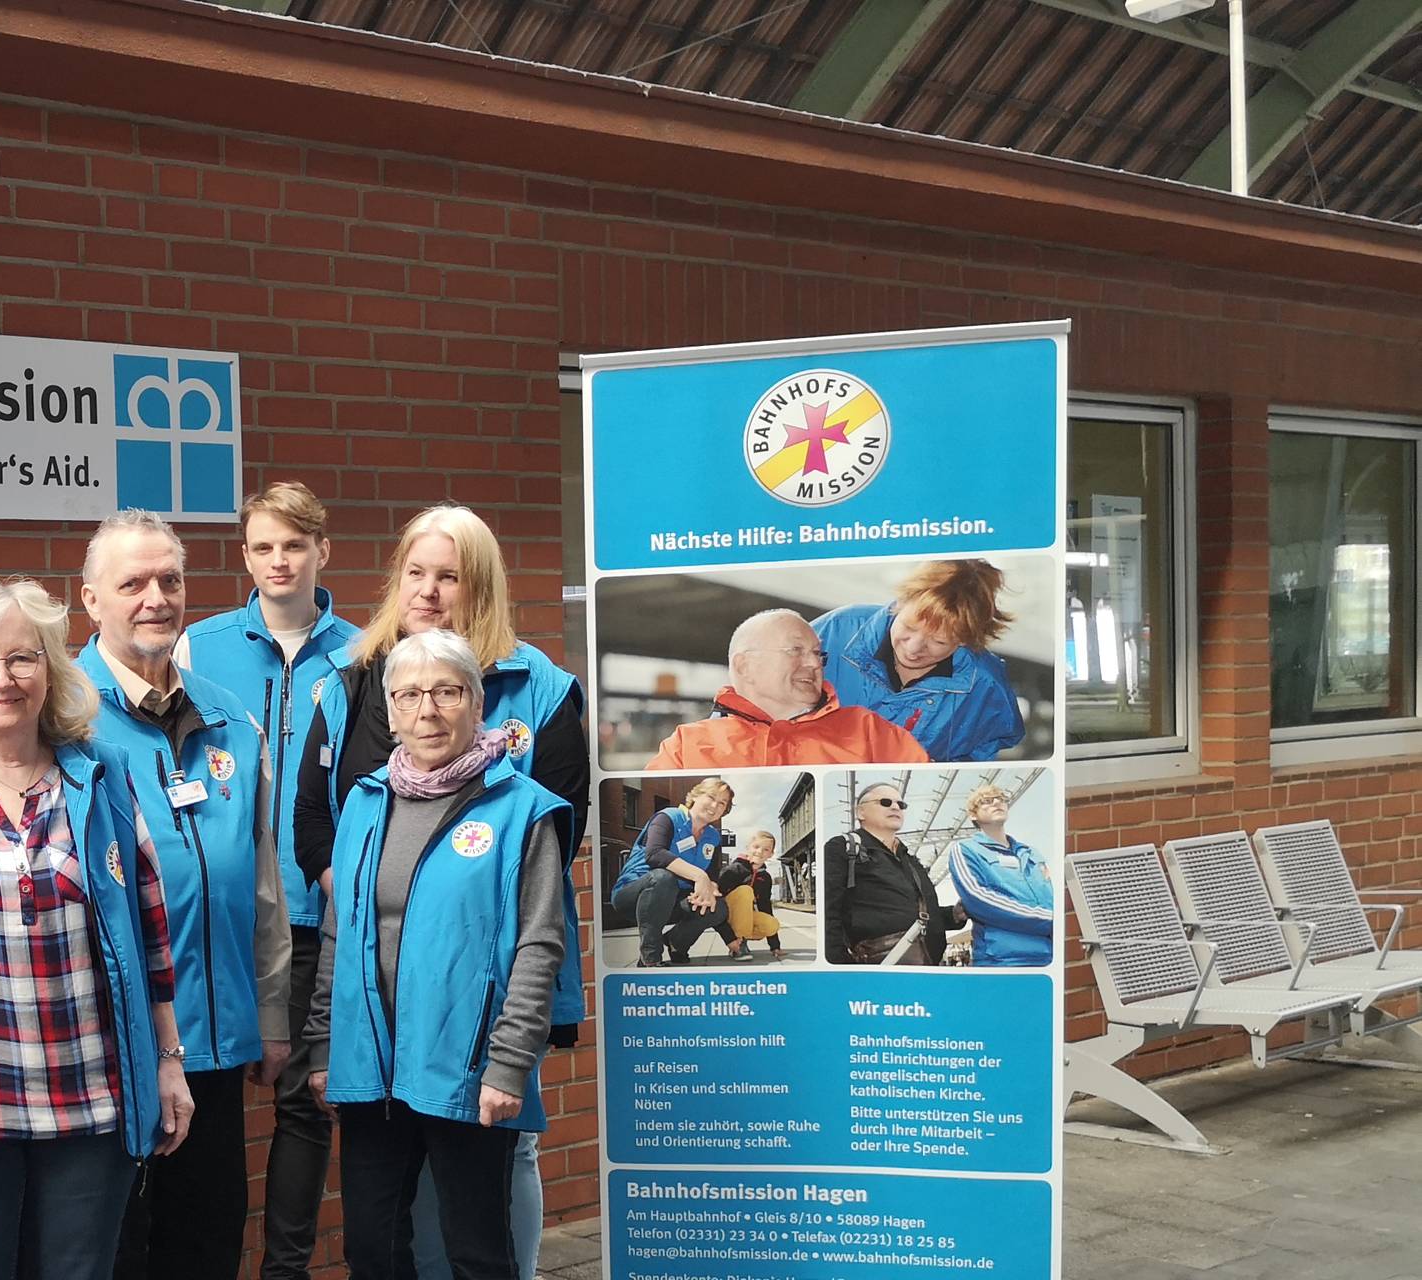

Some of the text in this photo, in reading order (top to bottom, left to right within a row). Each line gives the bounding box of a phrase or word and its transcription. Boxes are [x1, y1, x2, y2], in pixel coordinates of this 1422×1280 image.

[754, 378, 850, 452] BAHNHOFS
[43, 455, 100, 488] Aid.
[796, 436, 880, 499] MISSION
[650, 518, 994, 552] Nächste Hilfe: Bahnhofsmission.
[622, 980, 787, 996] Menschen brauchen
[622, 1002, 754, 1016] manchmal Hilfe.
[849, 1000, 931, 1018] Wir auch.
[623, 1034, 786, 1047] Die Bahnhofsmission hilft
[850, 1035, 984, 1050] Bahnhofsmissionen
[634, 1062, 698, 1073] auf Reisen
[850, 1052, 1001, 1068] sind Einrichtungen der
[850, 1069, 976, 1084] evangelischen und
[650, 1083, 688, 1094] Krisen
[692, 1082, 716, 1094] und
[720, 1082, 789, 1094] schlimmen
[850, 1085, 986, 1101] katholischen Kirche.
[635, 1099, 671, 1110] Nöten
[850, 1106, 1023, 1124] Bitte unterstützen Sie uns
[678, 1120, 696, 1131] sie
[699, 1119, 743, 1133] zuhört,
[748, 1120, 784, 1132] sowie
[787, 1120, 820, 1132] Ruhe
[850, 1122, 888, 1135] durch
[892, 1124, 917, 1136] Ihre
[921, 1125, 982, 1139] Mitarbeit
[636, 1136, 791, 1150] und Orientierung schafft.
[850, 1139, 969, 1156] oder Ihre Spende.
[627, 1182, 867, 1205] Bahnhofsmission Hagen
[627, 1210, 925, 1229] Am Hauptbahnhof Gleis 8/10 58089 Hagen
[627, 1228, 955, 1249] Telefon (02331) 23 34 0 Telefax (02231) 18 25 85
[628, 1245, 994, 1269] hagen@bahnhofsmission.de www.bahnhofsmission.de
